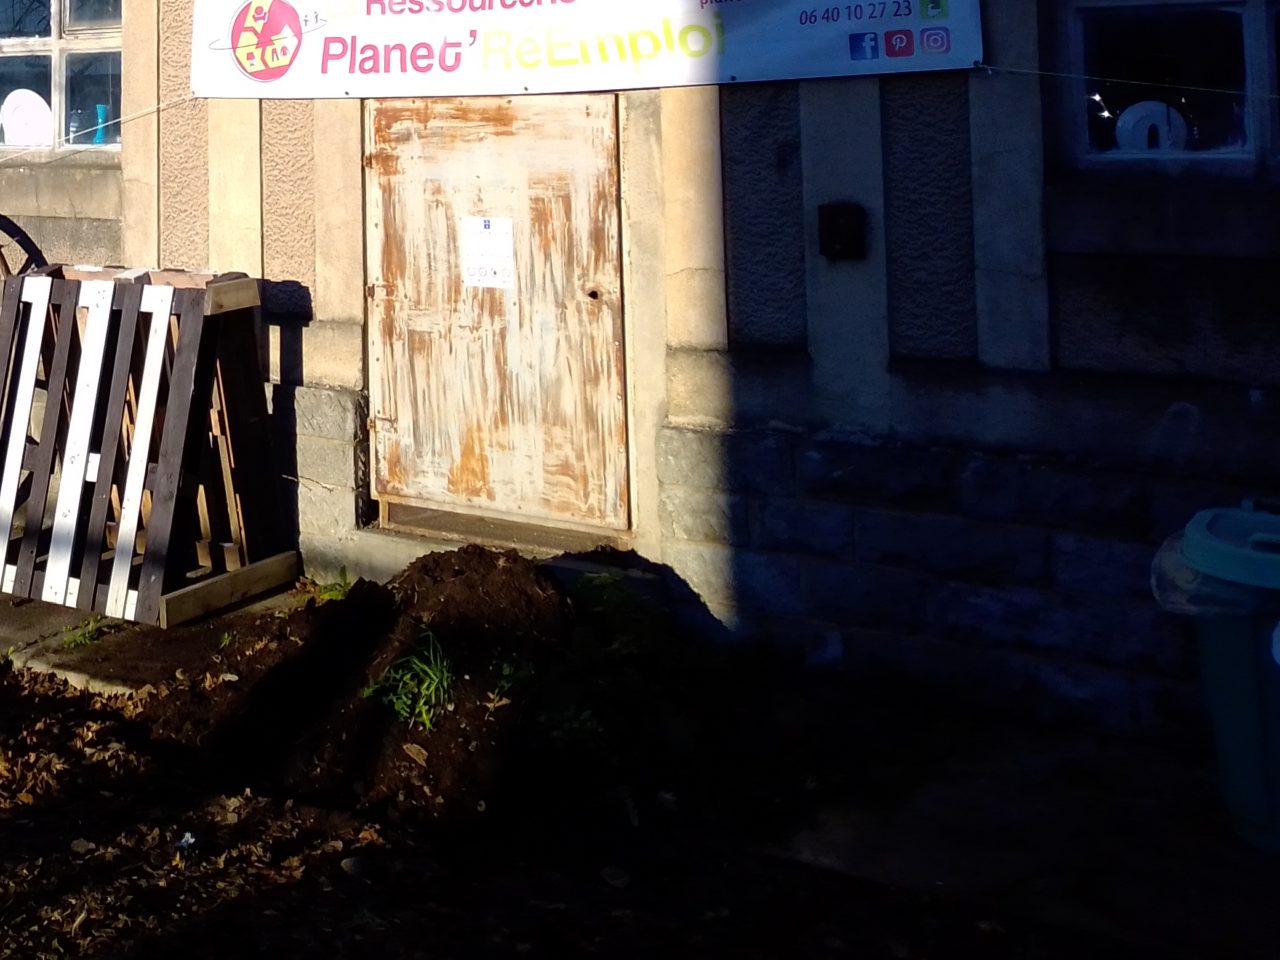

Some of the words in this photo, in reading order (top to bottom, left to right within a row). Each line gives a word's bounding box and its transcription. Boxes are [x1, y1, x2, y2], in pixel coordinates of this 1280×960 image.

[799, 10, 817, 25] 06
[821, 7, 840, 23] 40
[847, 4, 863, 20] 10
[868, 2, 887, 19] 27
[893, 0, 912, 17] 23
